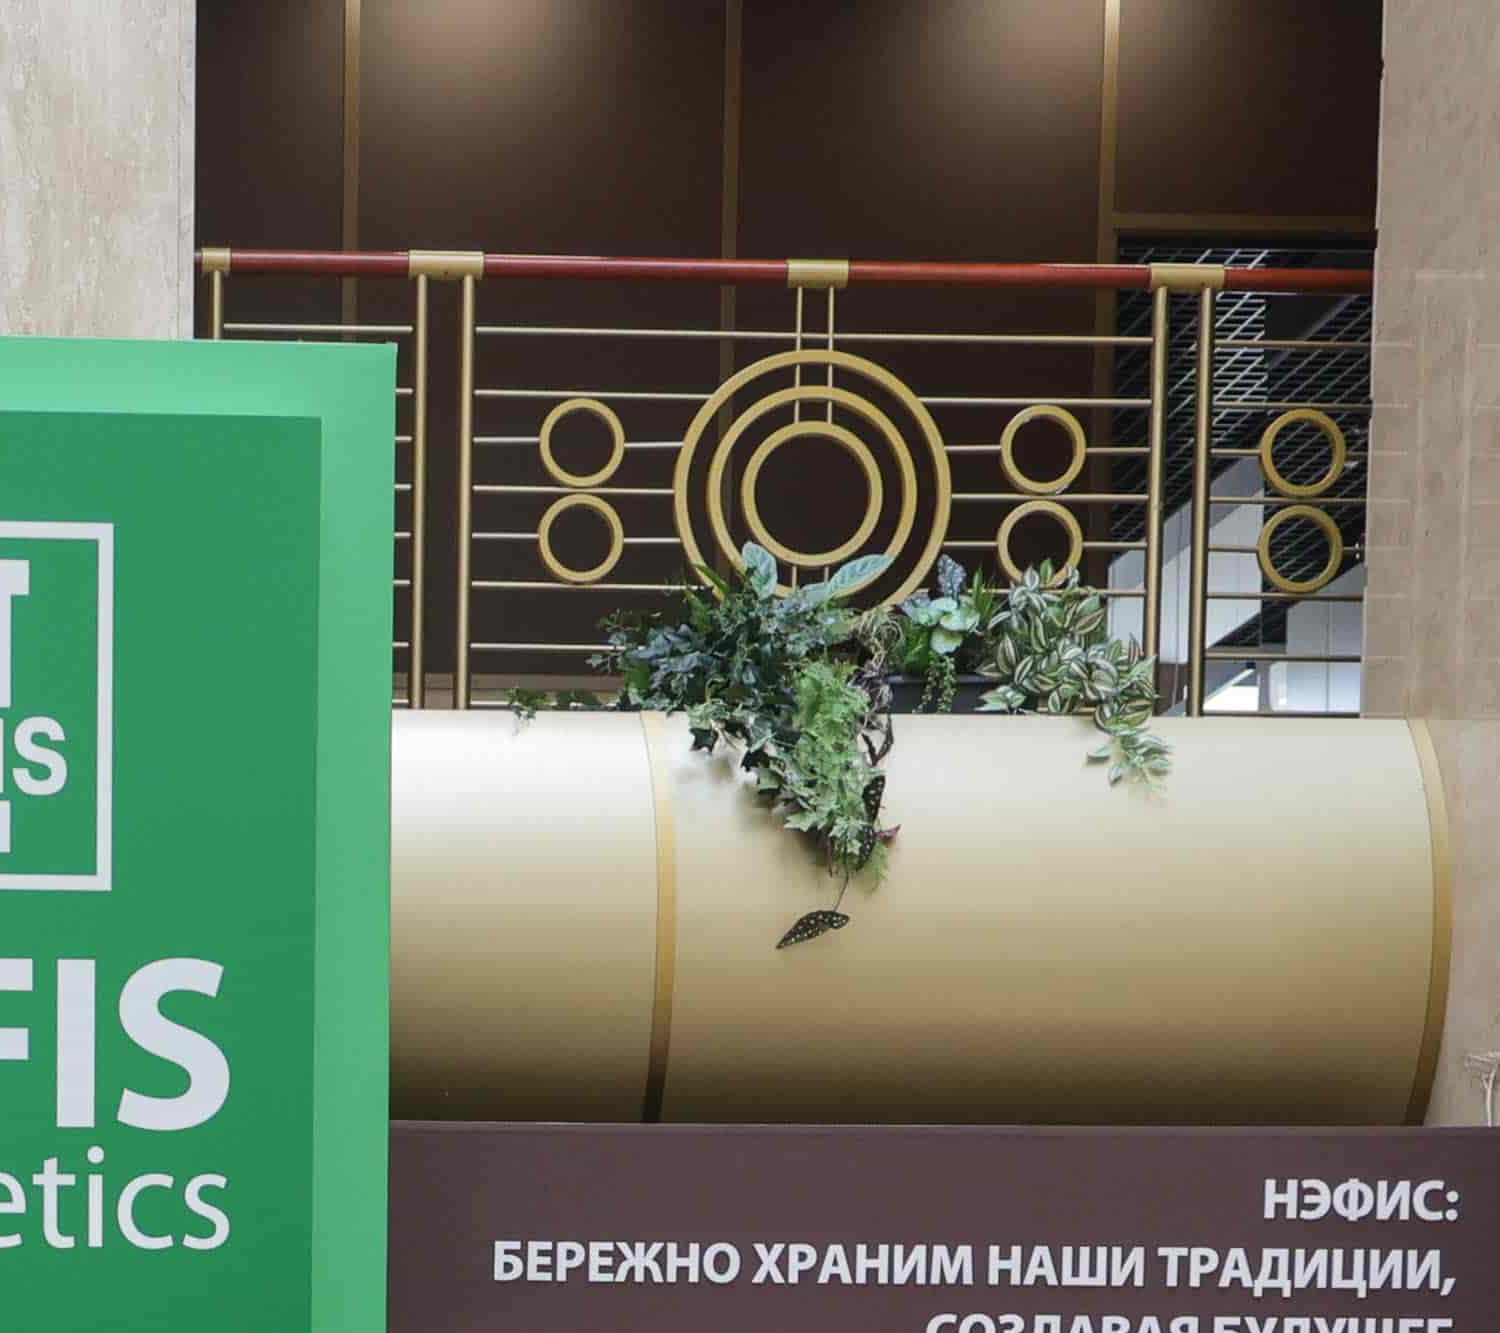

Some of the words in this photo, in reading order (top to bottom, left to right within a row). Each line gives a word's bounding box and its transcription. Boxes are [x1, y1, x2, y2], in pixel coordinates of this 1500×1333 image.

[1263, 1178, 1459, 1221] НЭФИС:
[493, 1240, 741, 1284] БЕРЕЖНО
[752, 1242, 973, 1286] ХРАНИМ
[987, 1245, 1145, 1287] НАШИ
[1157, 1246, 1455, 1299] ТРАДИЦИИ,
